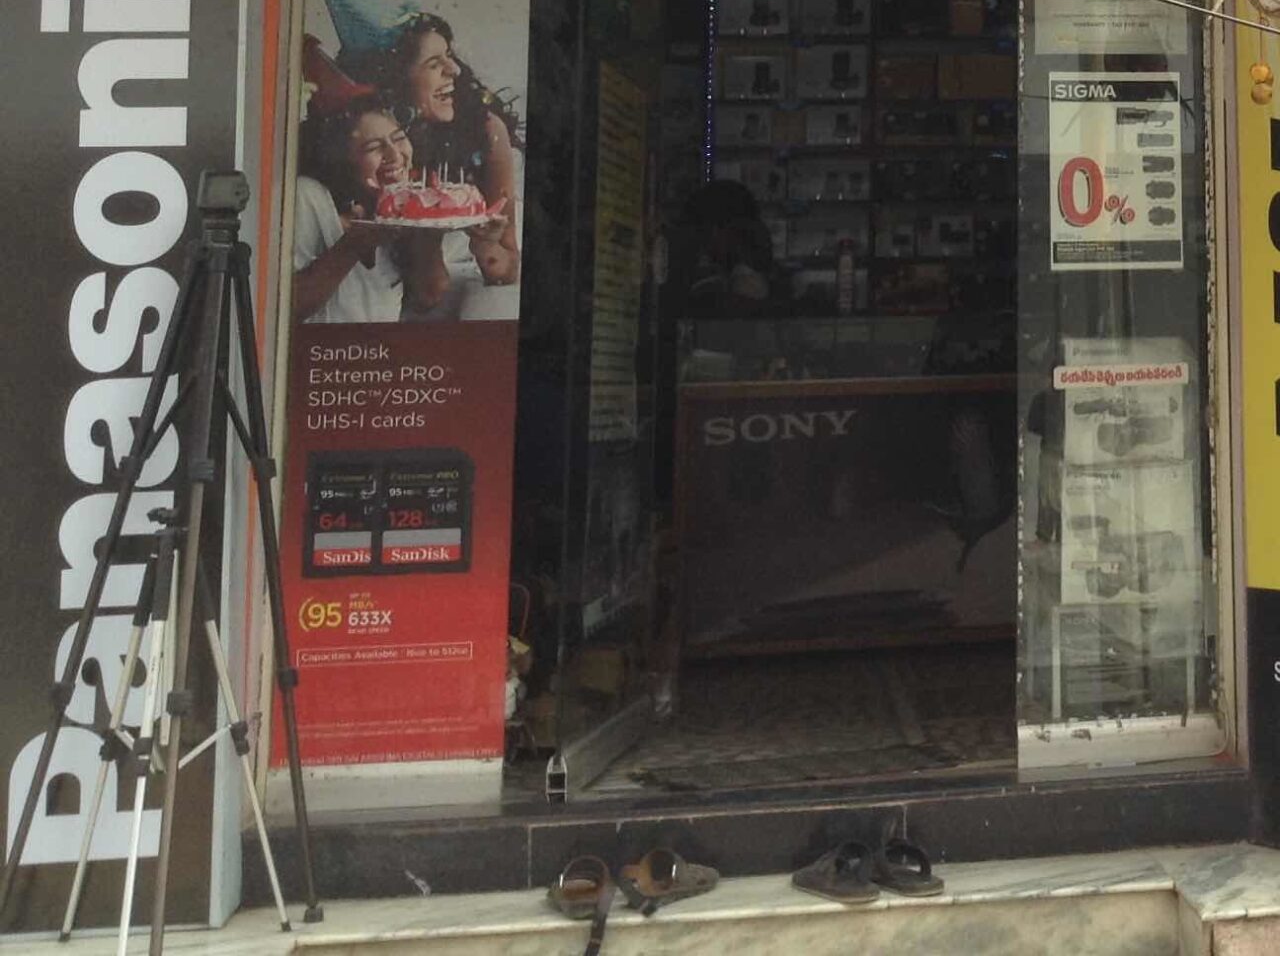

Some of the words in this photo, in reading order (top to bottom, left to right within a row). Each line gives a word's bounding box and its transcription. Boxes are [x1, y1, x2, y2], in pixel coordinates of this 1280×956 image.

[1053, 83, 1117, 100] SIGMA
[1057, 156, 1136, 228] 0%
[309, 344, 390, 362] SanDisk
[308, 367, 394, 386] Extreme
[306, 413, 365, 430] UHS-I
[370, 411, 426, 429] cards
[704, 410, 857, 446] SONY
[319, 512, 347, 530] 64
[388, 509, 424, 528] 128
[390, 547, 450, 563] SanDisk
[347, 610, 393, 627] 633X
